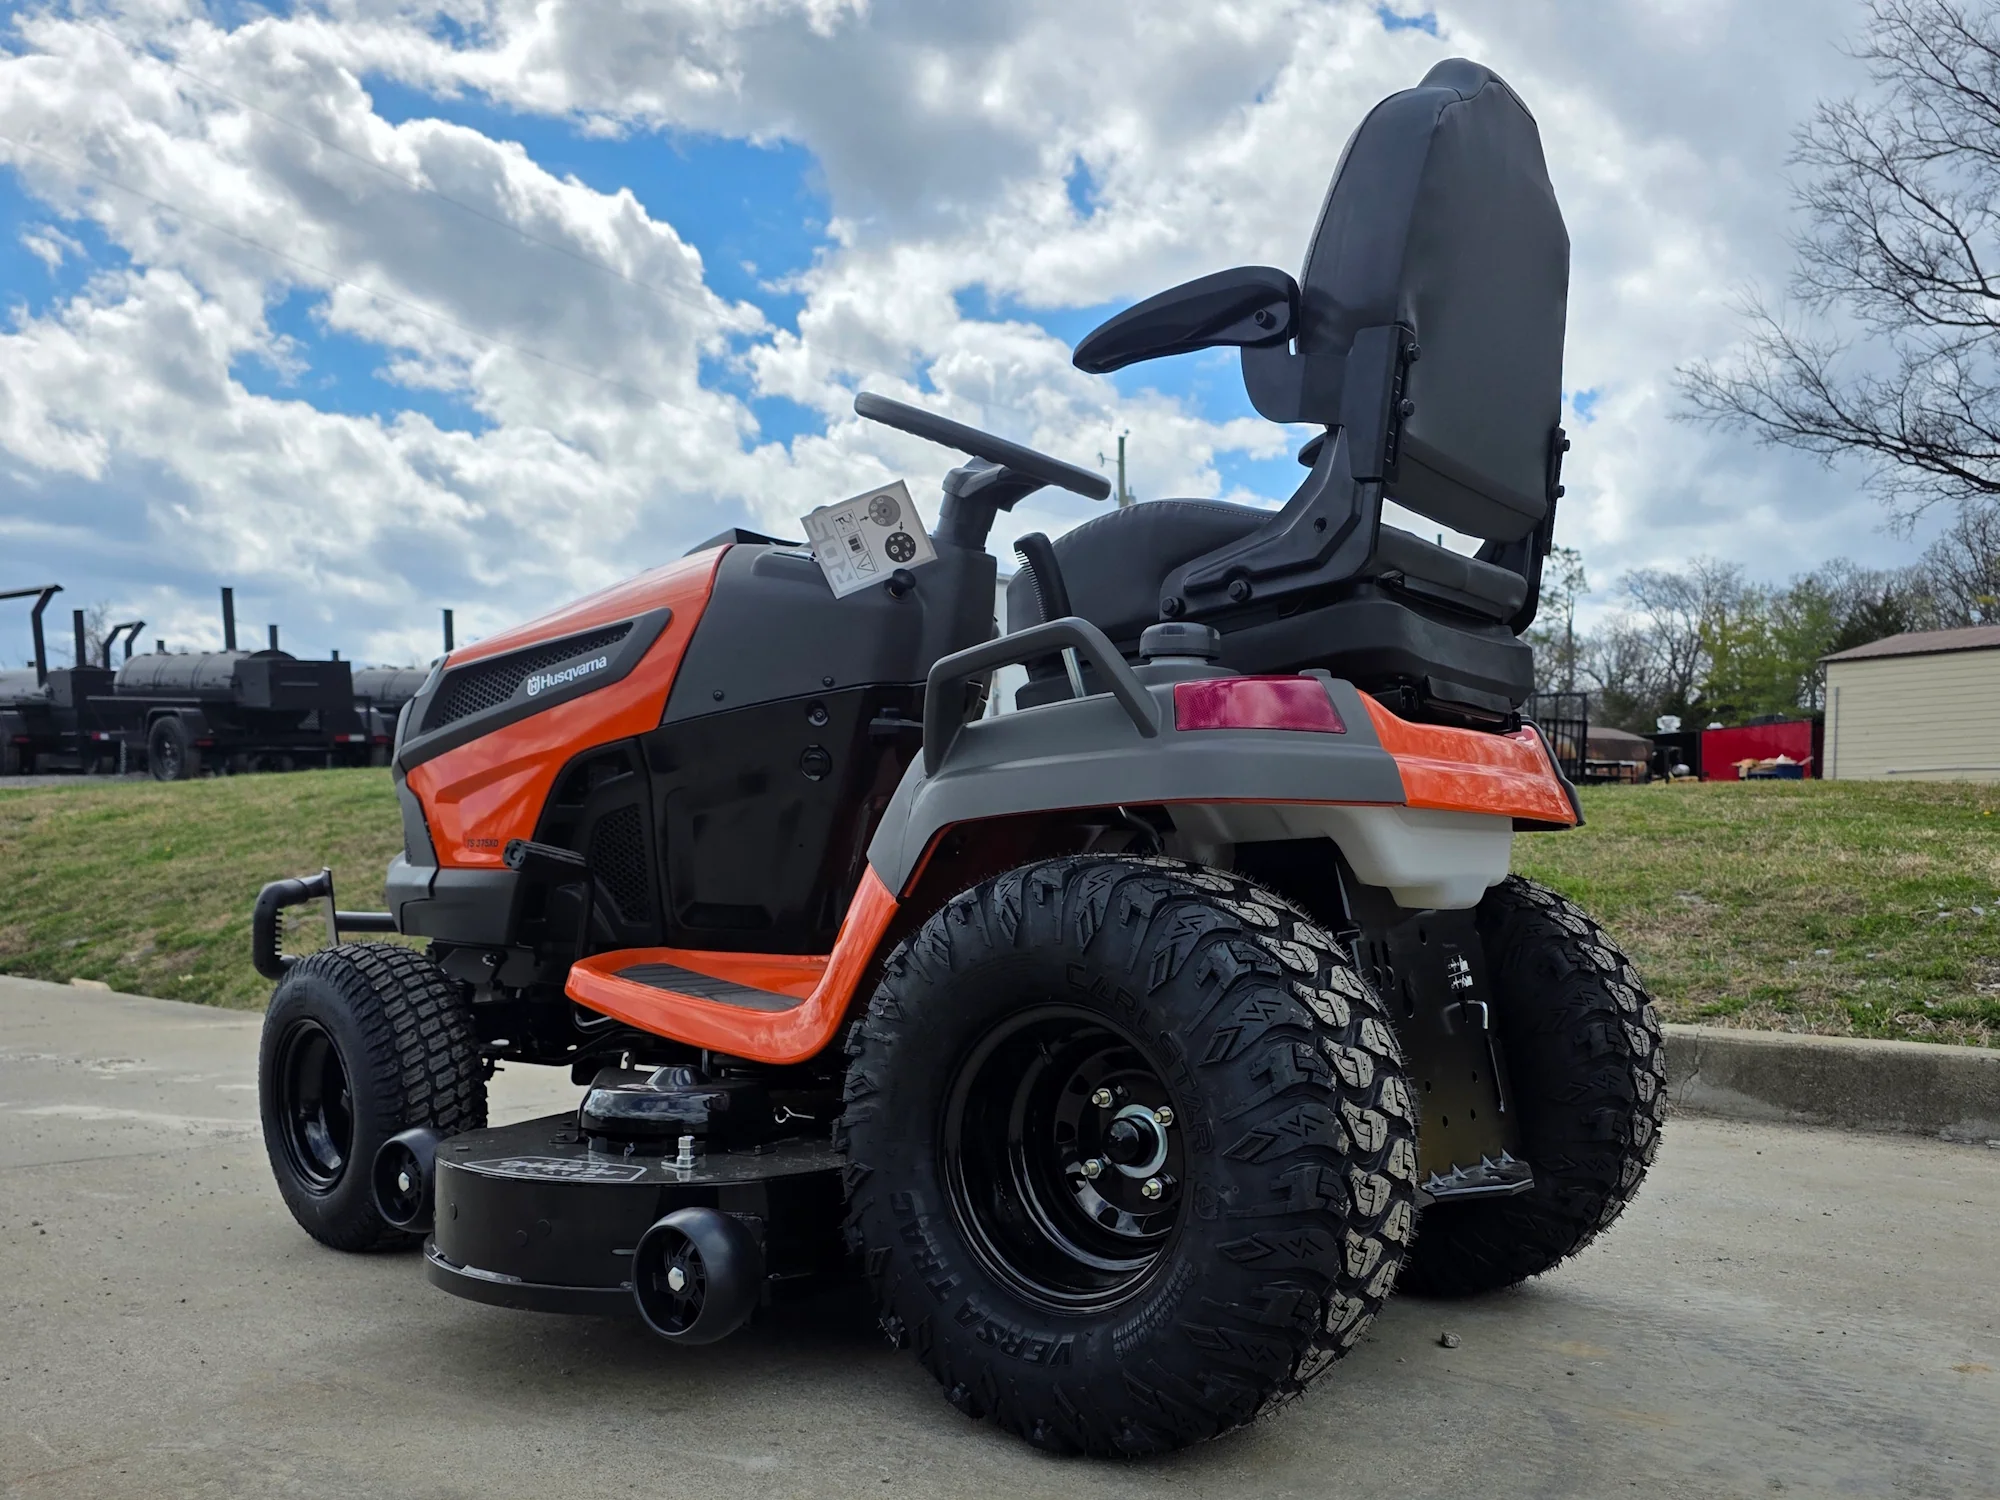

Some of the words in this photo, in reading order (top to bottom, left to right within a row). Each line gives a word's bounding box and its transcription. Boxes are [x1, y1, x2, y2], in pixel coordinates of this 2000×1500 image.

[806, 512, 857, 593] ROS
[541, 656, 607, 690] Husqvarna
[890, 1190, 960, 1303] TRAC
[953, 1297, 1075, 1368] VERSA
